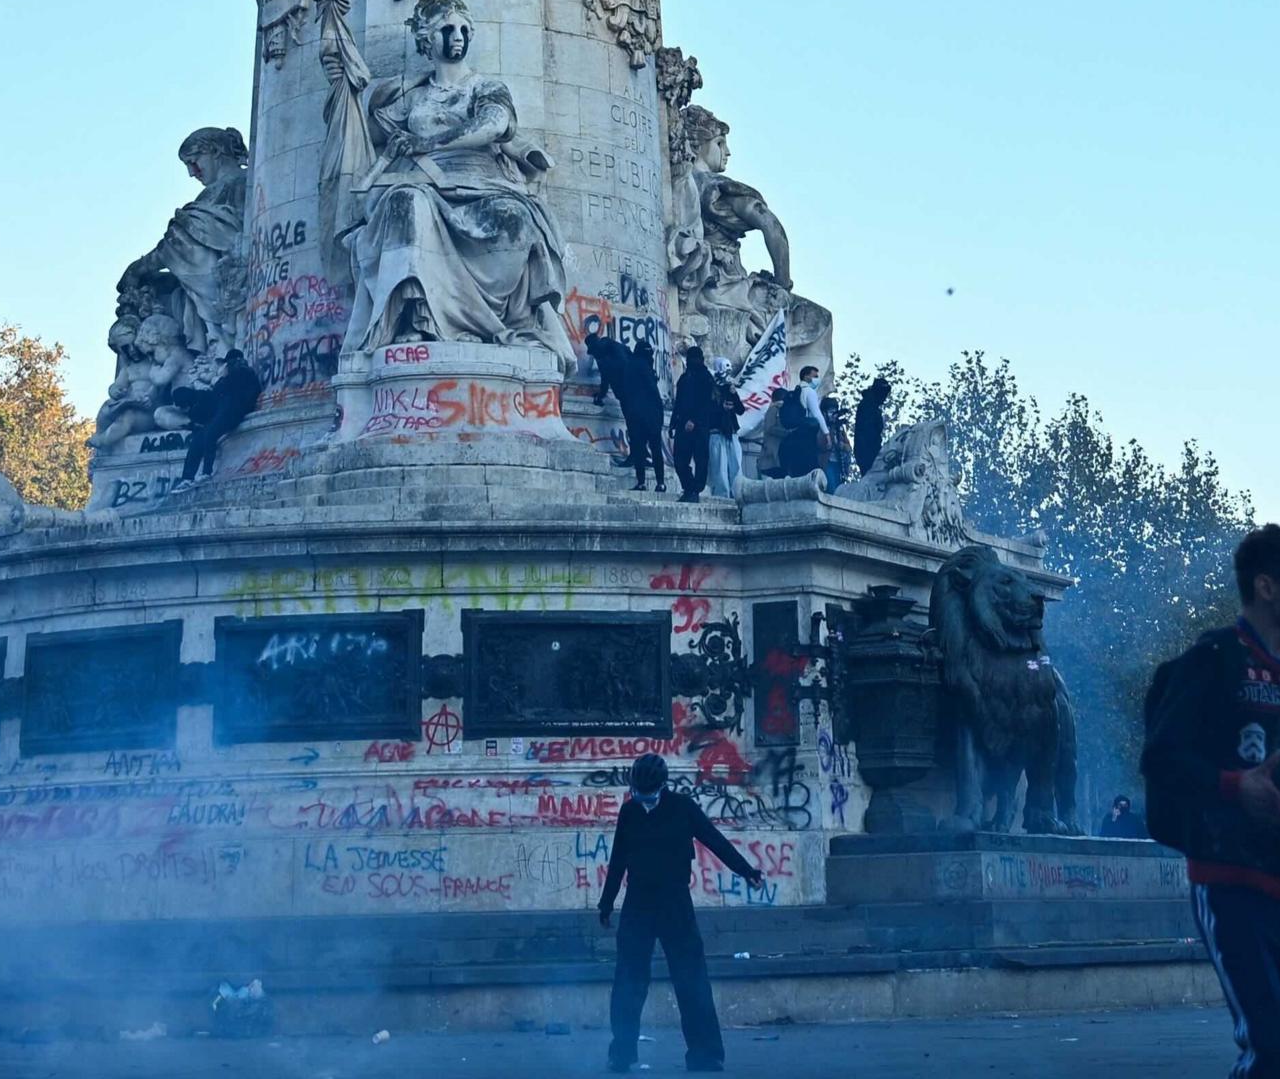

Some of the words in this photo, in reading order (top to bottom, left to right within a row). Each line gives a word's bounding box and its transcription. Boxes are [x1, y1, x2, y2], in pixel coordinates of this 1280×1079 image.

[385, 345, 430, 365] ACAB
[373, 387, 408, 412] NIK
[517, 566, 593, 585] JUILLET
[603, 567, 644, 584] 1880
[304, 844, 339, 871] LA
[513, 840, 576, 890] ACAB
[322, 875, 355, 896] EN
